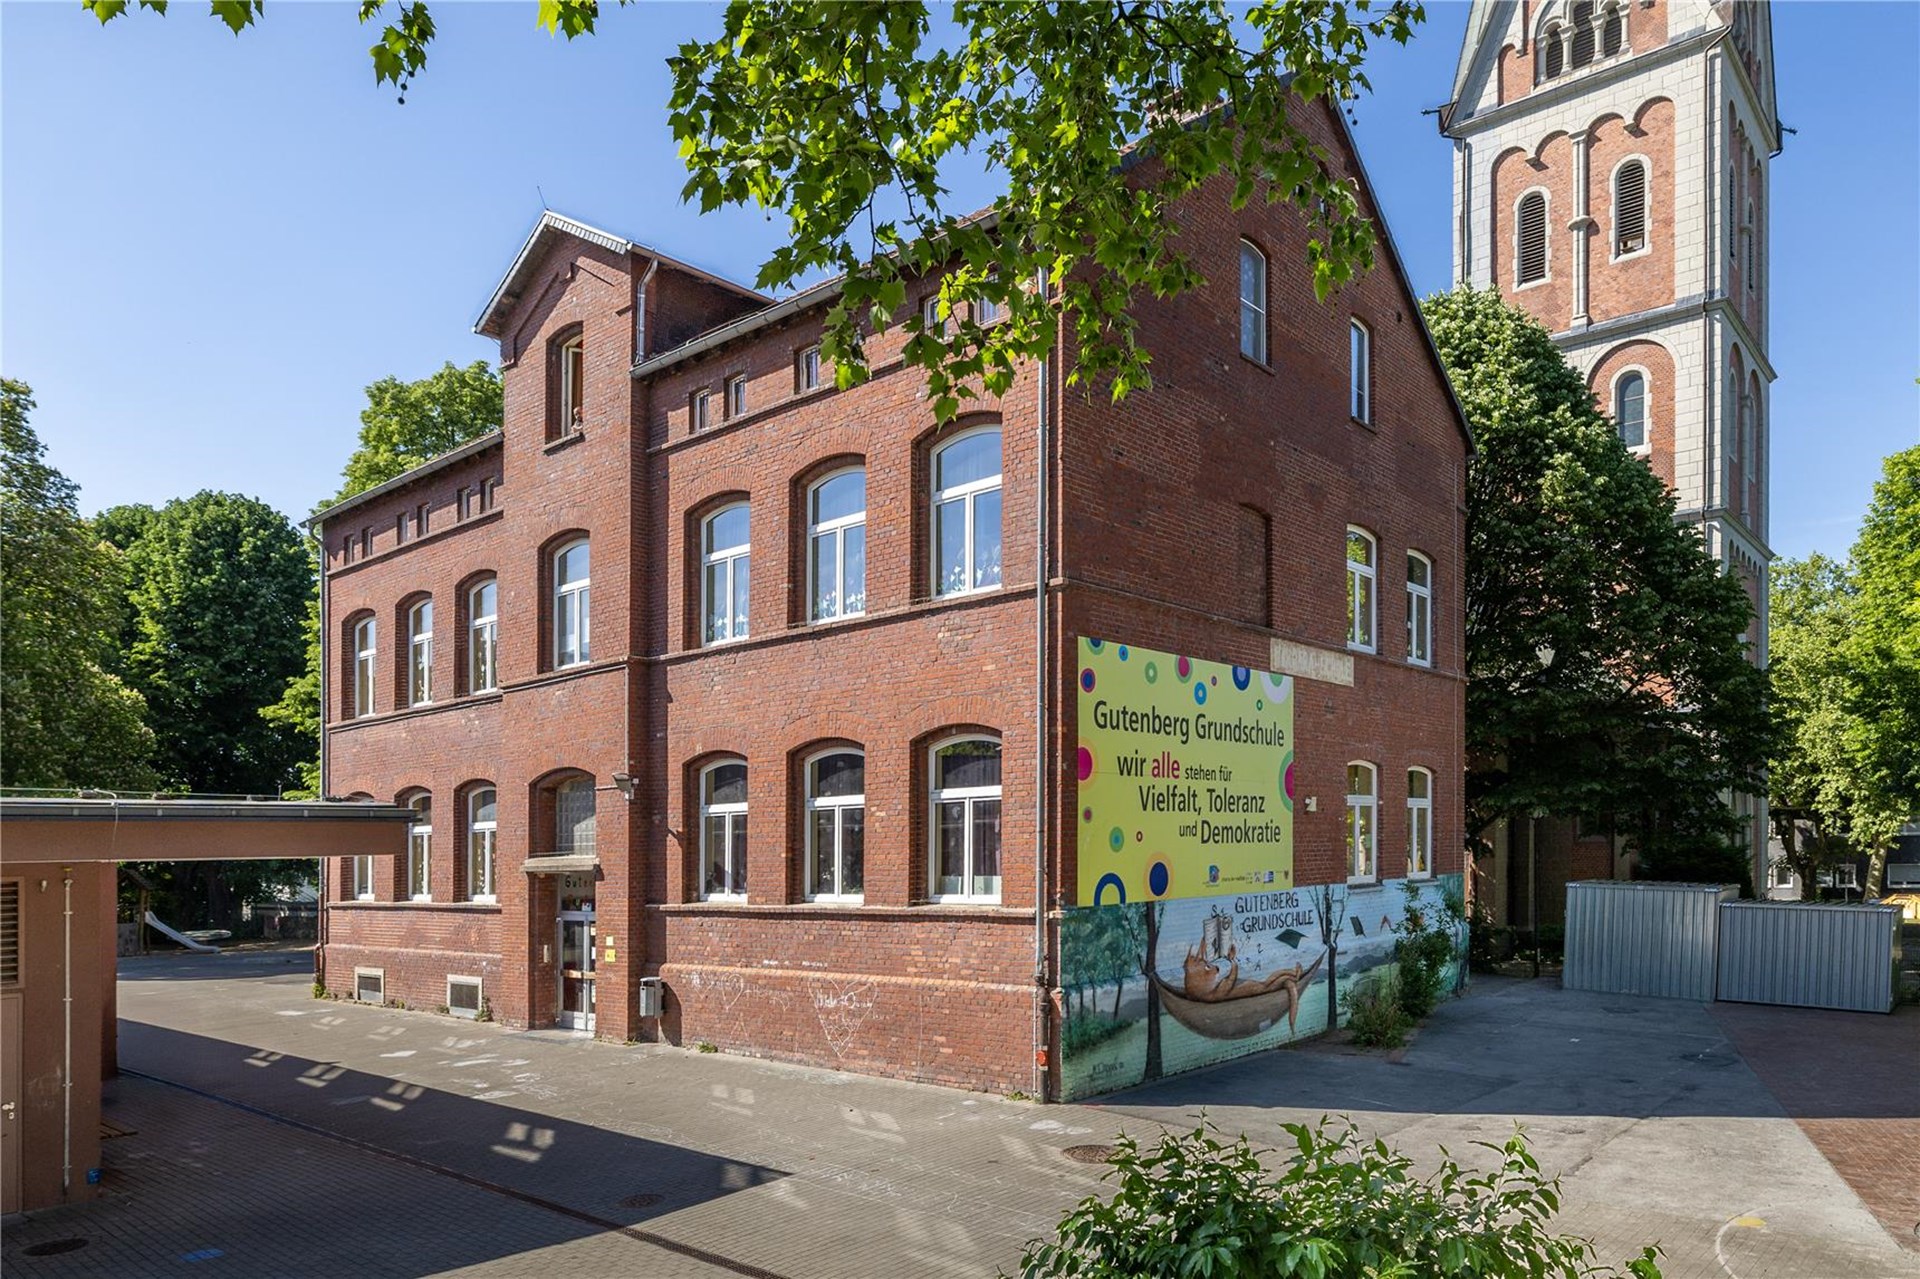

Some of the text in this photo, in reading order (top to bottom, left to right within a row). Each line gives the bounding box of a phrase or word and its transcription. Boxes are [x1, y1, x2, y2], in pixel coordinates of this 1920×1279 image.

[1094, 700, 1285, 747] Gutenberg Grundschule
[1117, 750, 1232, 782] wir alle stehen für
[1139, 785, 1265, 815] Vielfalt, Toleranz
[1179, 820, 1281, 844] und Demokratie
[1235, 892, 1299, 914] GUTENBERG
[1243, 911, 1313, 933] GRUNDSCHULE
